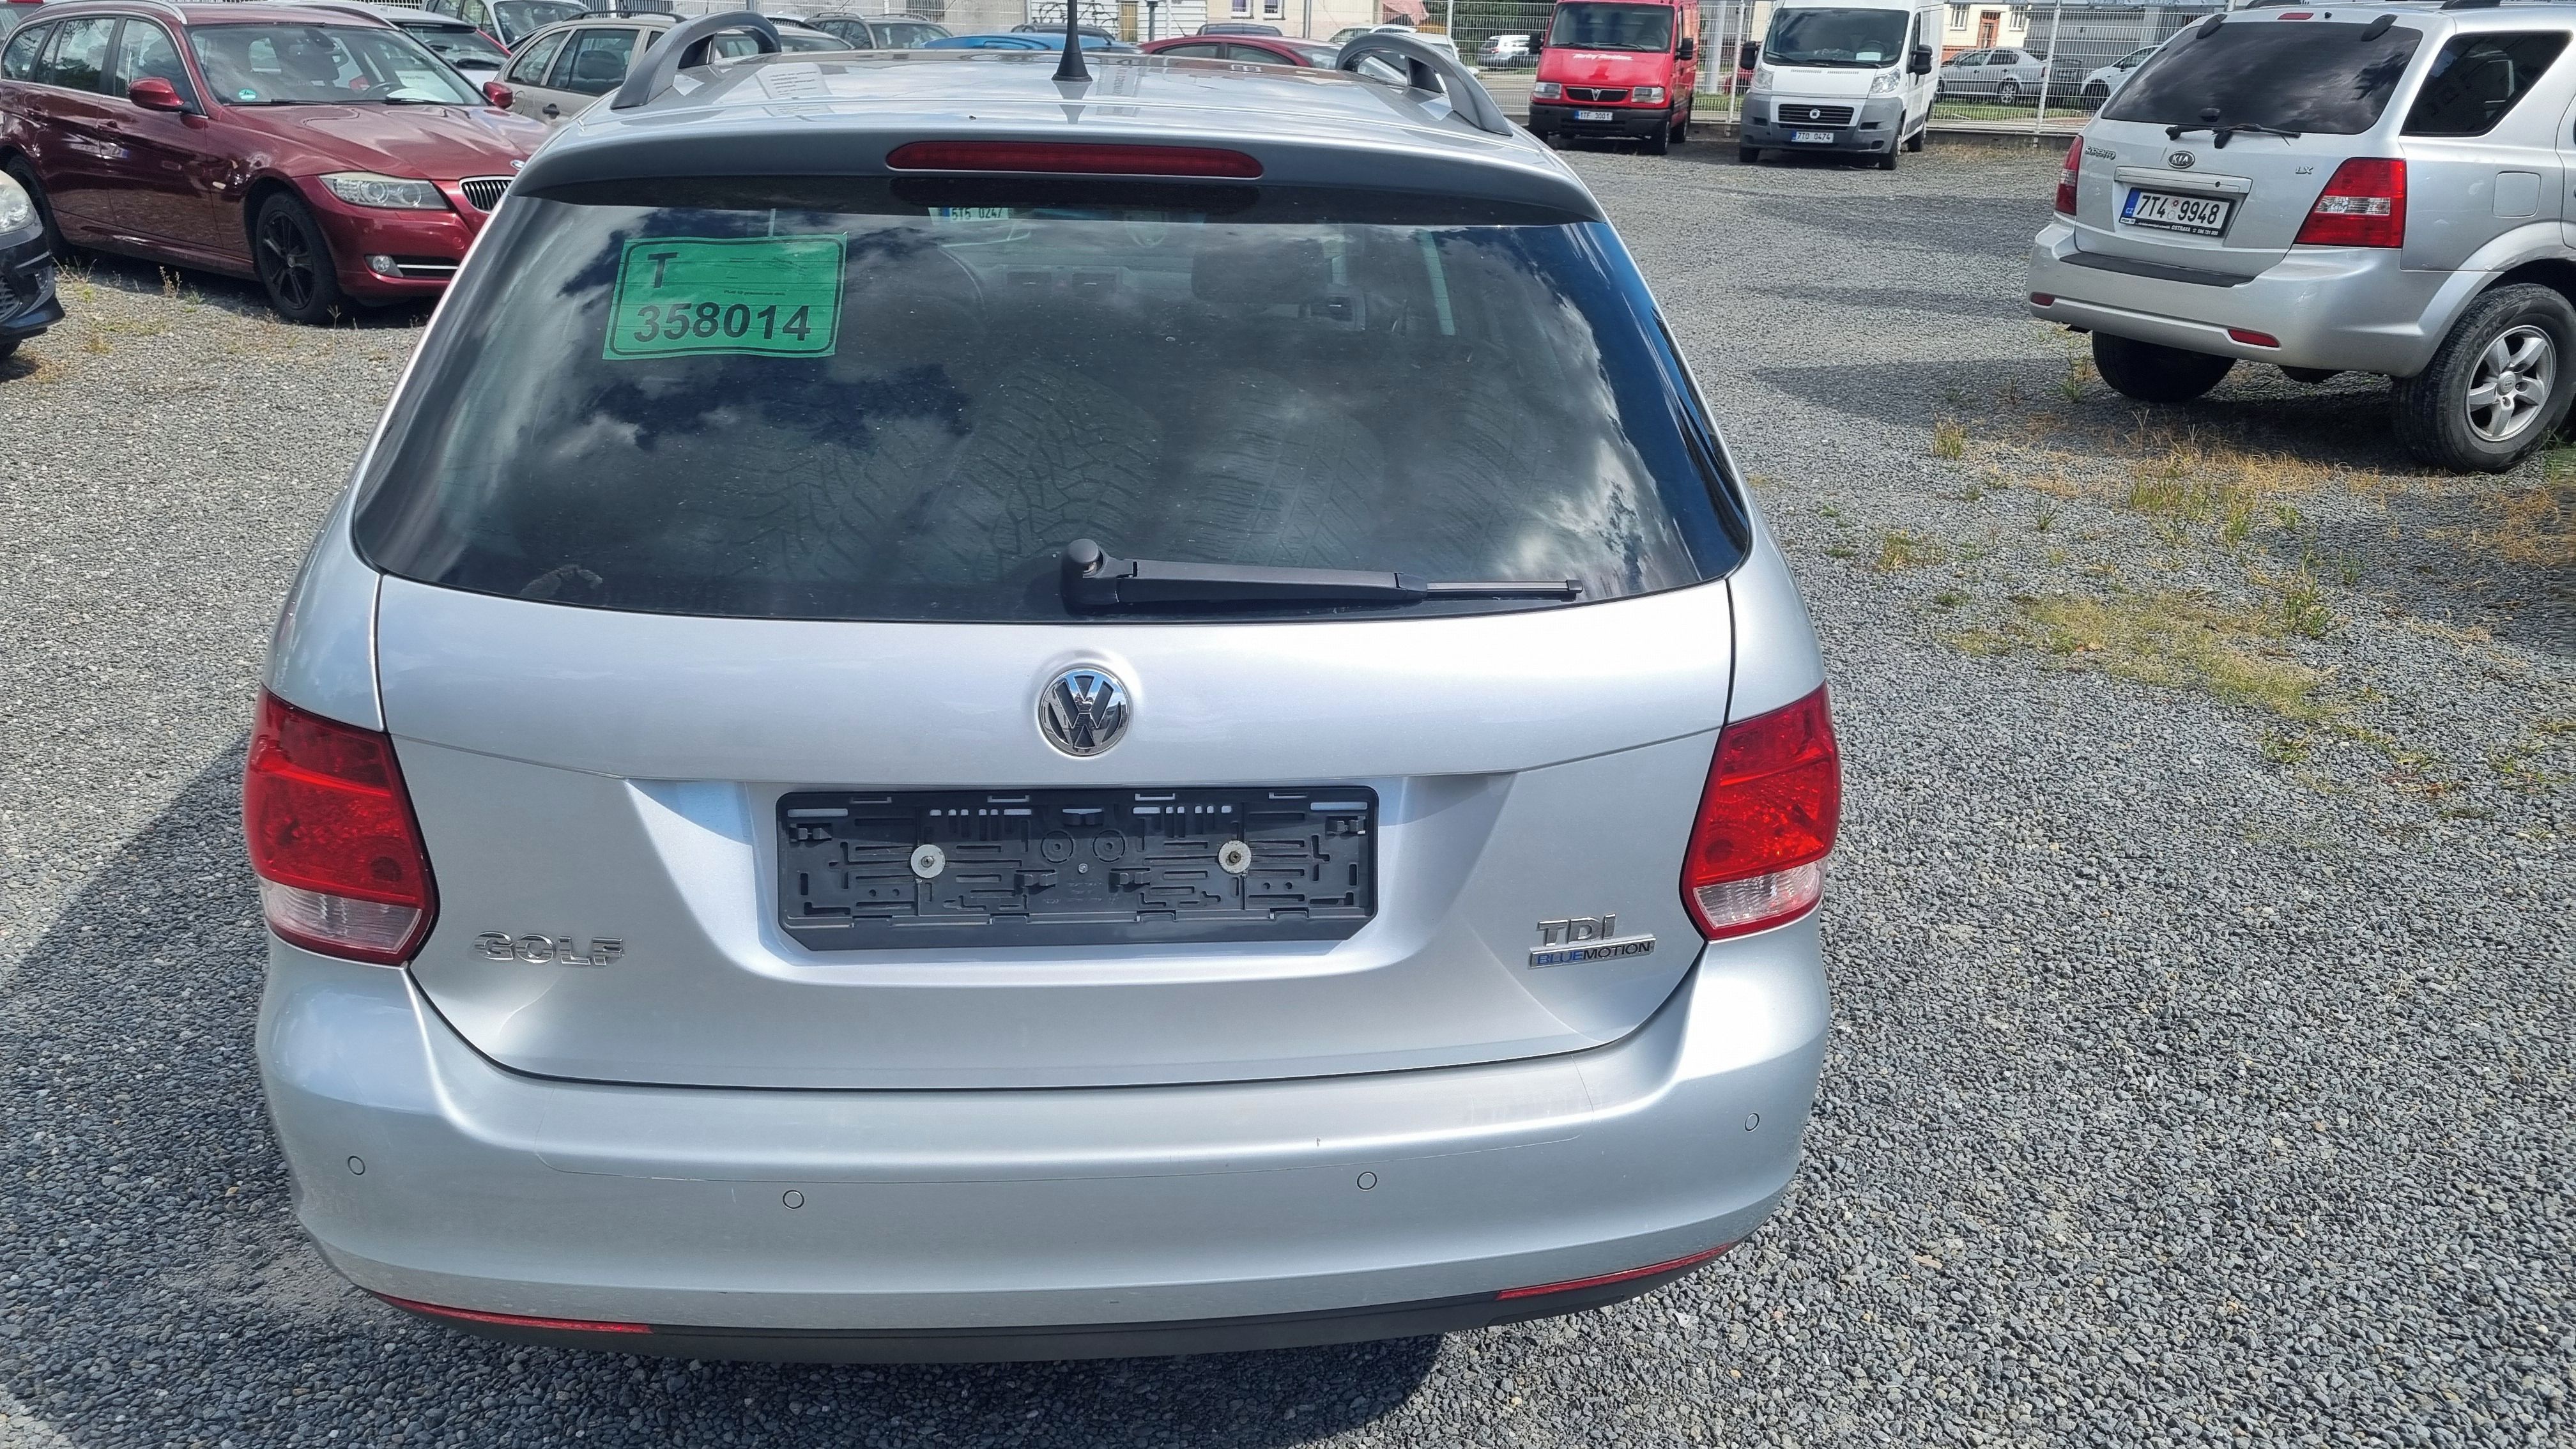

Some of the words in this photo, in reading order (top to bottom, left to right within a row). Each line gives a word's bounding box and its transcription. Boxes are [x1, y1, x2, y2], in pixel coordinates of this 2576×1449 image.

[2172, 155, 2188, 165] KIA
[2295, 165, 2313, 174] LX
[2136, 195, 2168, 218] 7T4
[2177, 200, 2220, 224] 9948
[647, 252, 678, 288] T
[633, 302, 811, 342] 358014
[1039, 667, 1129, 756] VW
[1537, 913, 1616, 947] TDI
[474, 931, 624, 967] GOLF
[1537, 942, 1650, 965] BLUEMOTION
